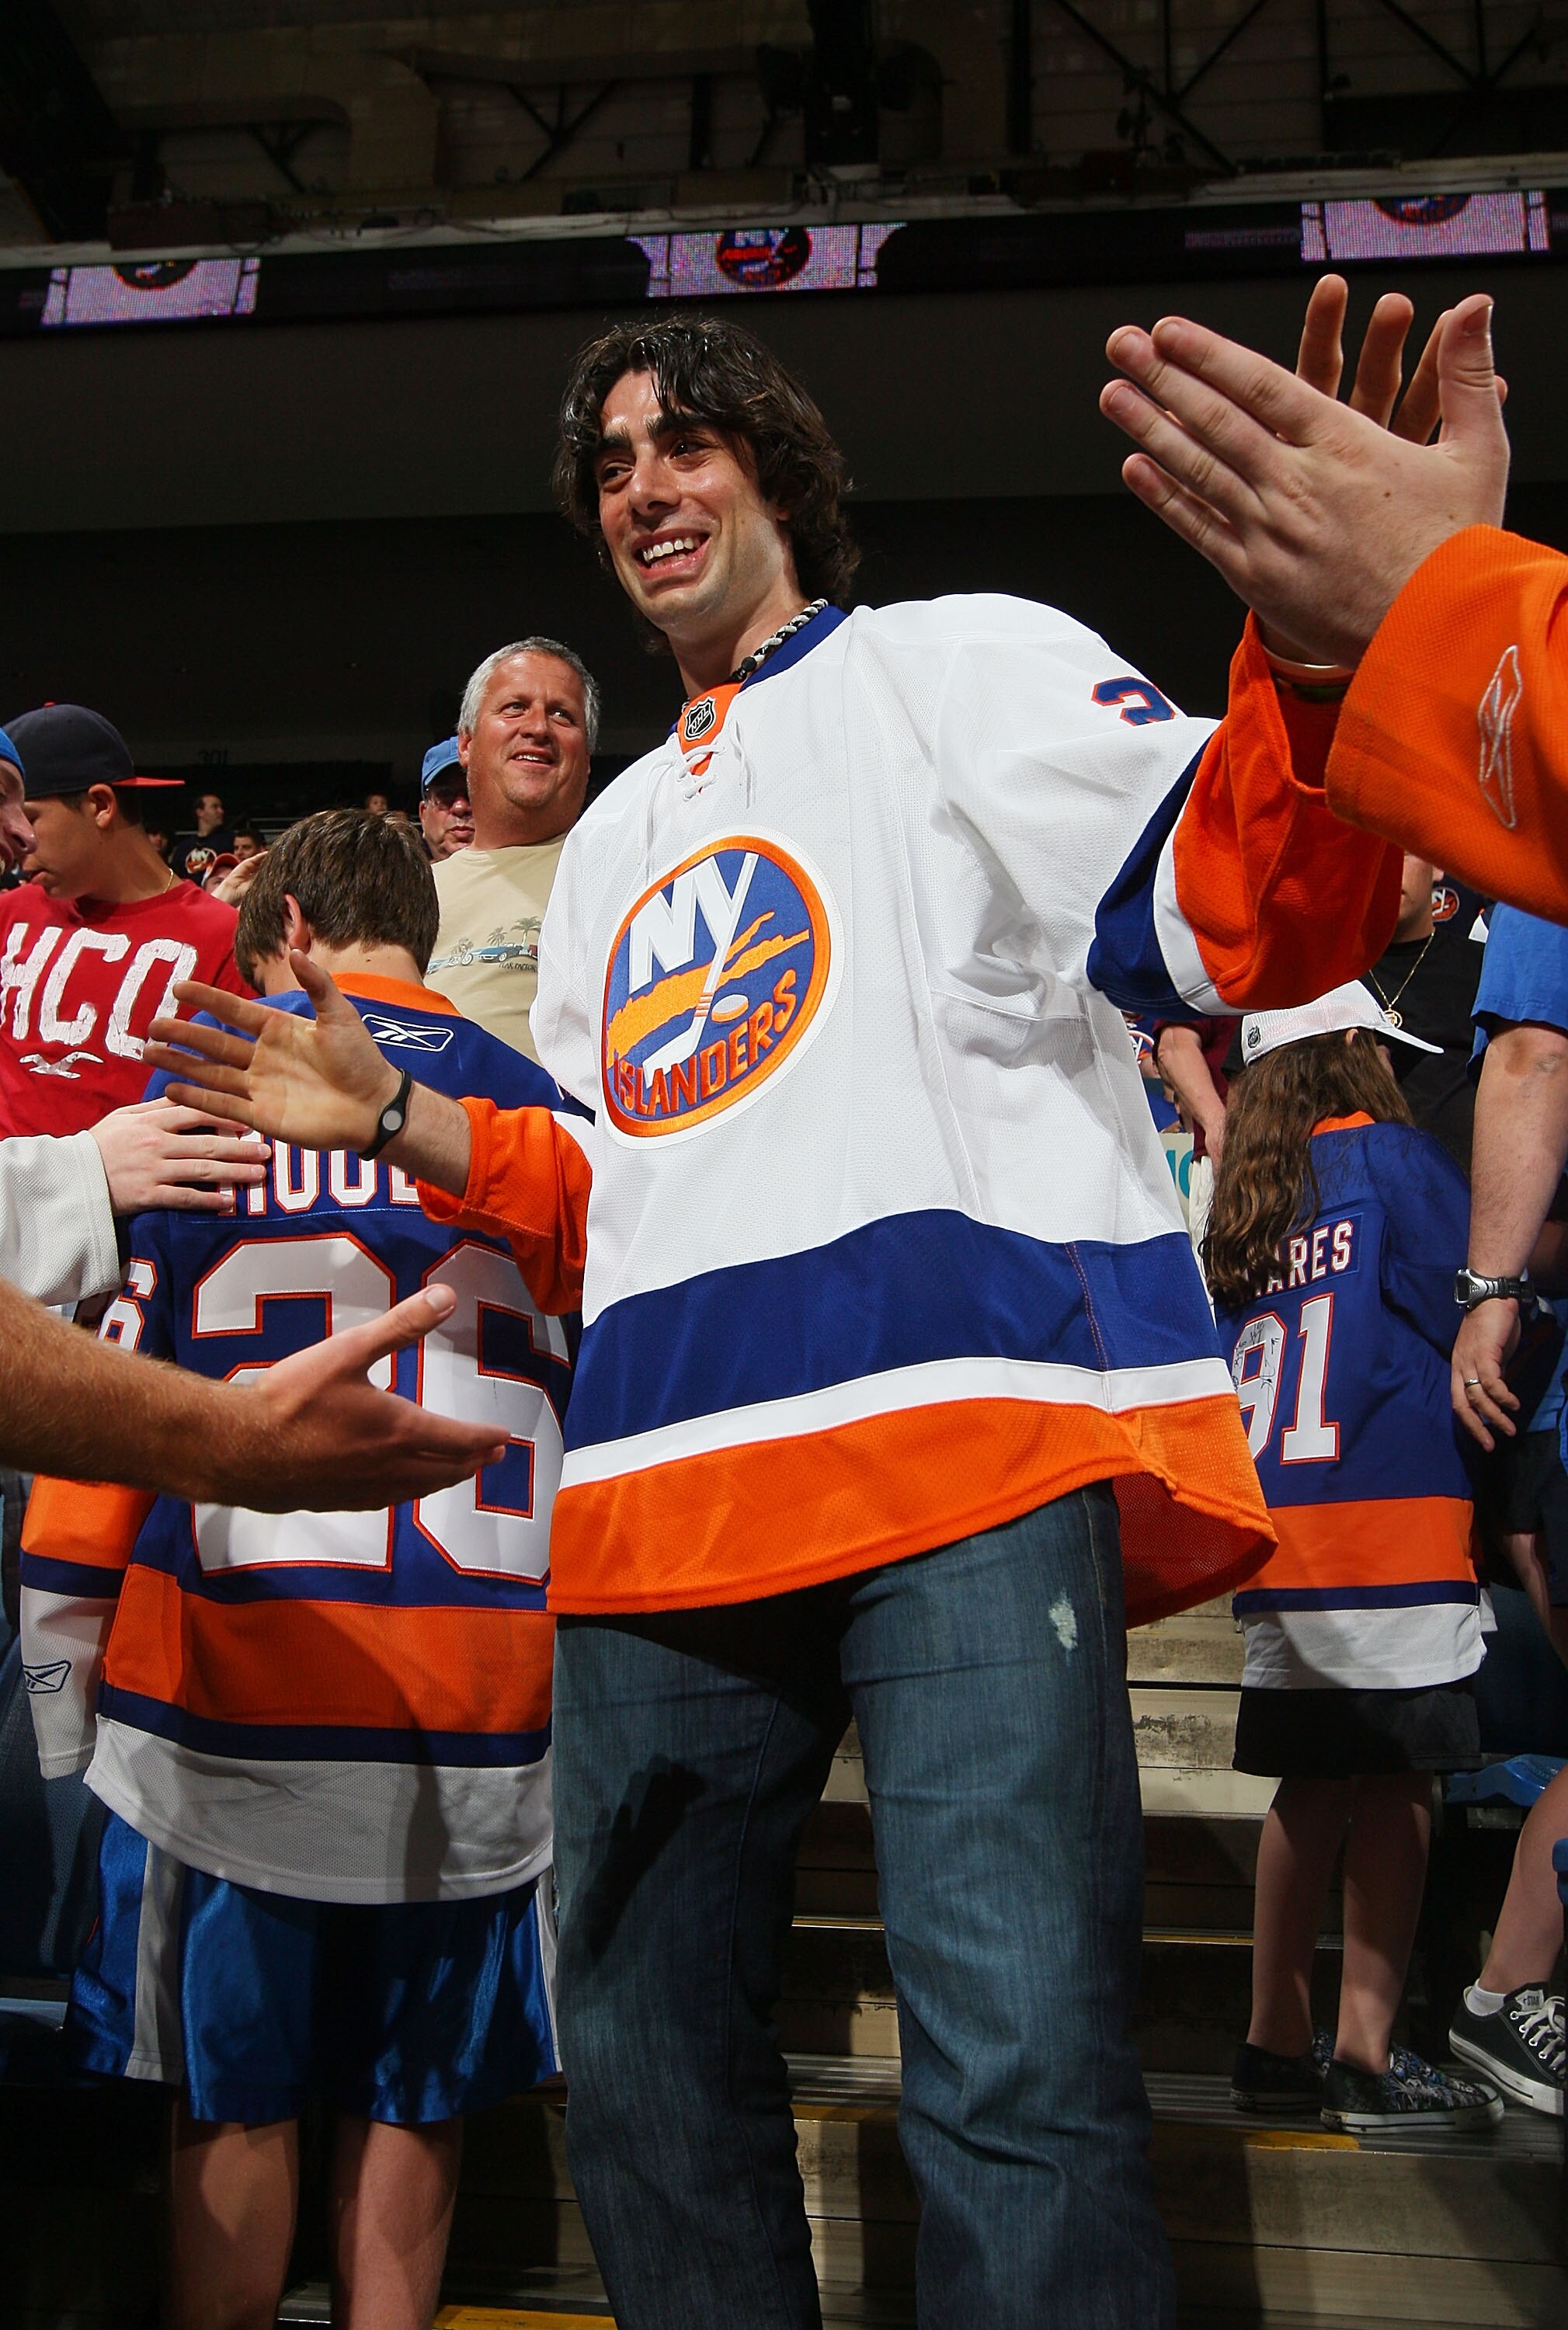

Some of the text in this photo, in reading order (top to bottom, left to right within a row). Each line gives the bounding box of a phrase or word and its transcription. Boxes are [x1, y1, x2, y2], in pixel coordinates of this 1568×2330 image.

[690, 706, 710, 735] NHL
[628, 852, 760, 995] NY
[614, 968, 798, 1116] ISLANDERS
[1243, 1219, 1354, 1299] ARES
[191, 1231, 572, 1586] 26
[1232, 1292, 1340, 1466] 91
